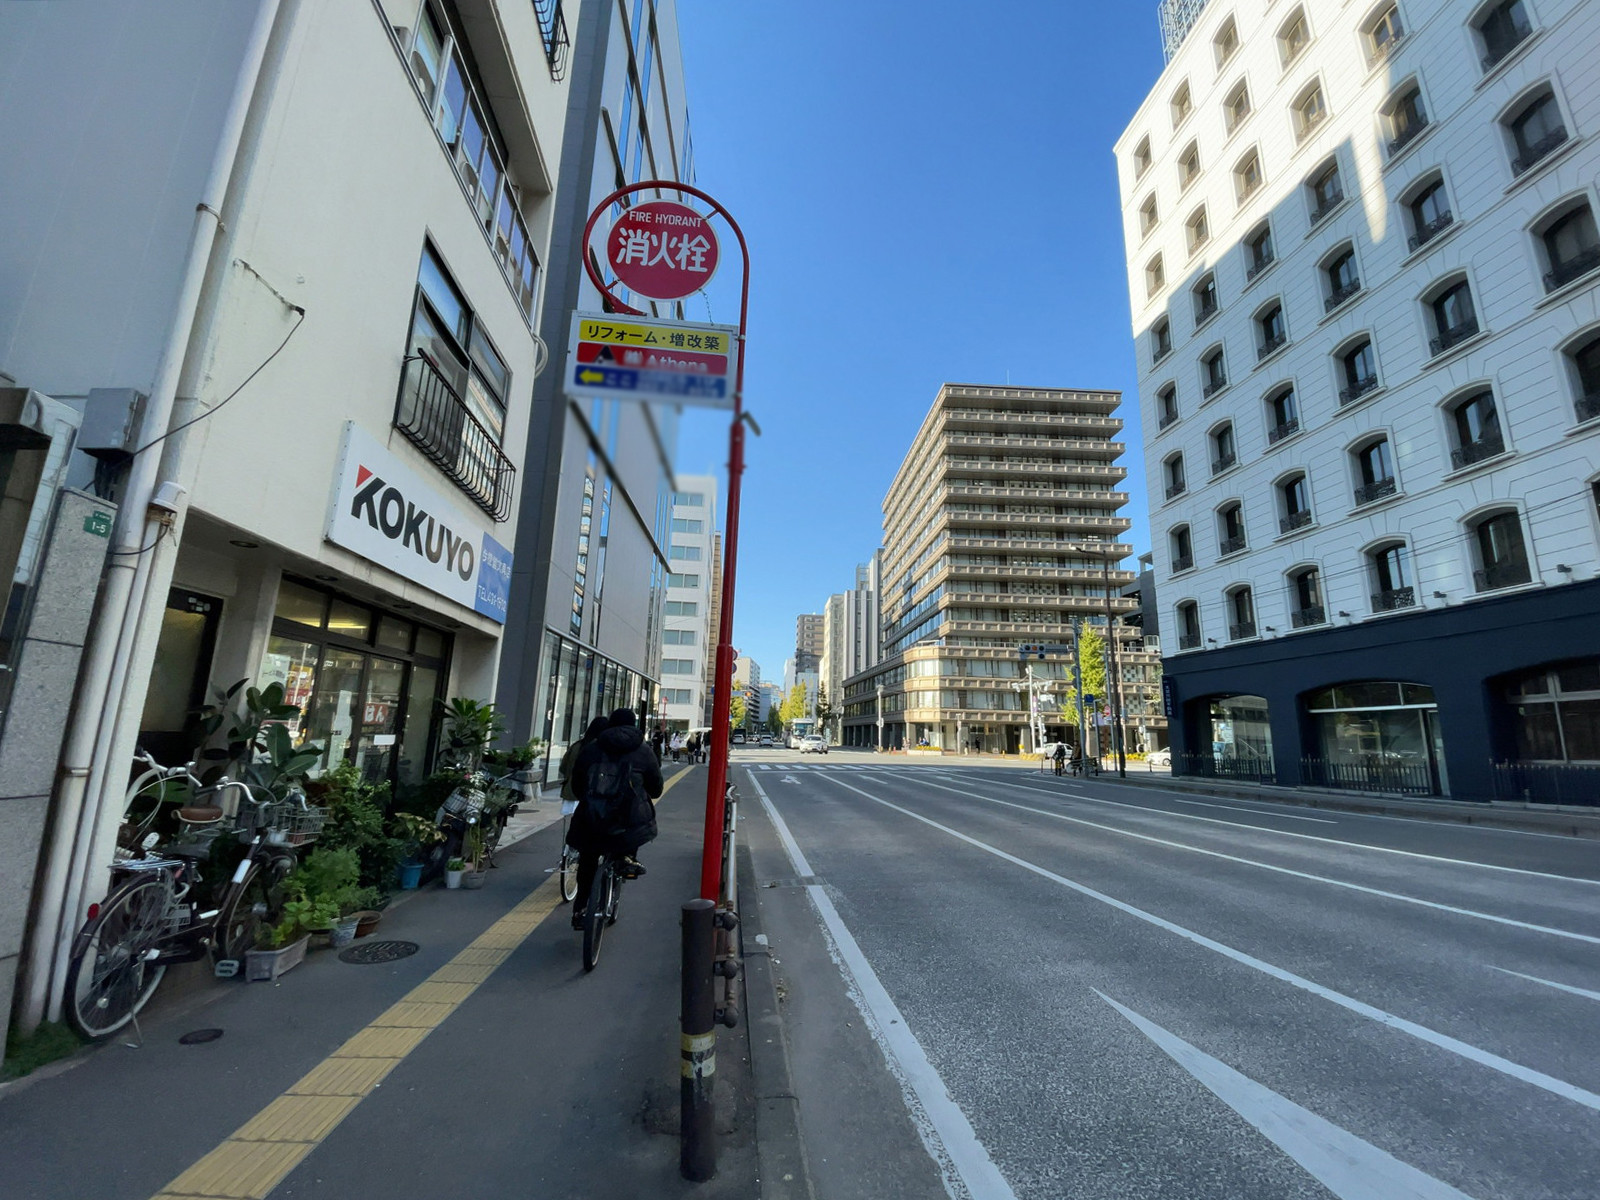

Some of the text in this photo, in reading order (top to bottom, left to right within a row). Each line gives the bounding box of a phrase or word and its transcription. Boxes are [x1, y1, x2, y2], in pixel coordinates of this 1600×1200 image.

[629, 211, 703, 228] FIRE HYDRANT
[616, 227, 711, 273] 消火栓
[588, 325, 720, 350] リフォーム・増改築
[92, 521, 107, 533] 1-5
[351, 464, 474, 581] KOKUYO
